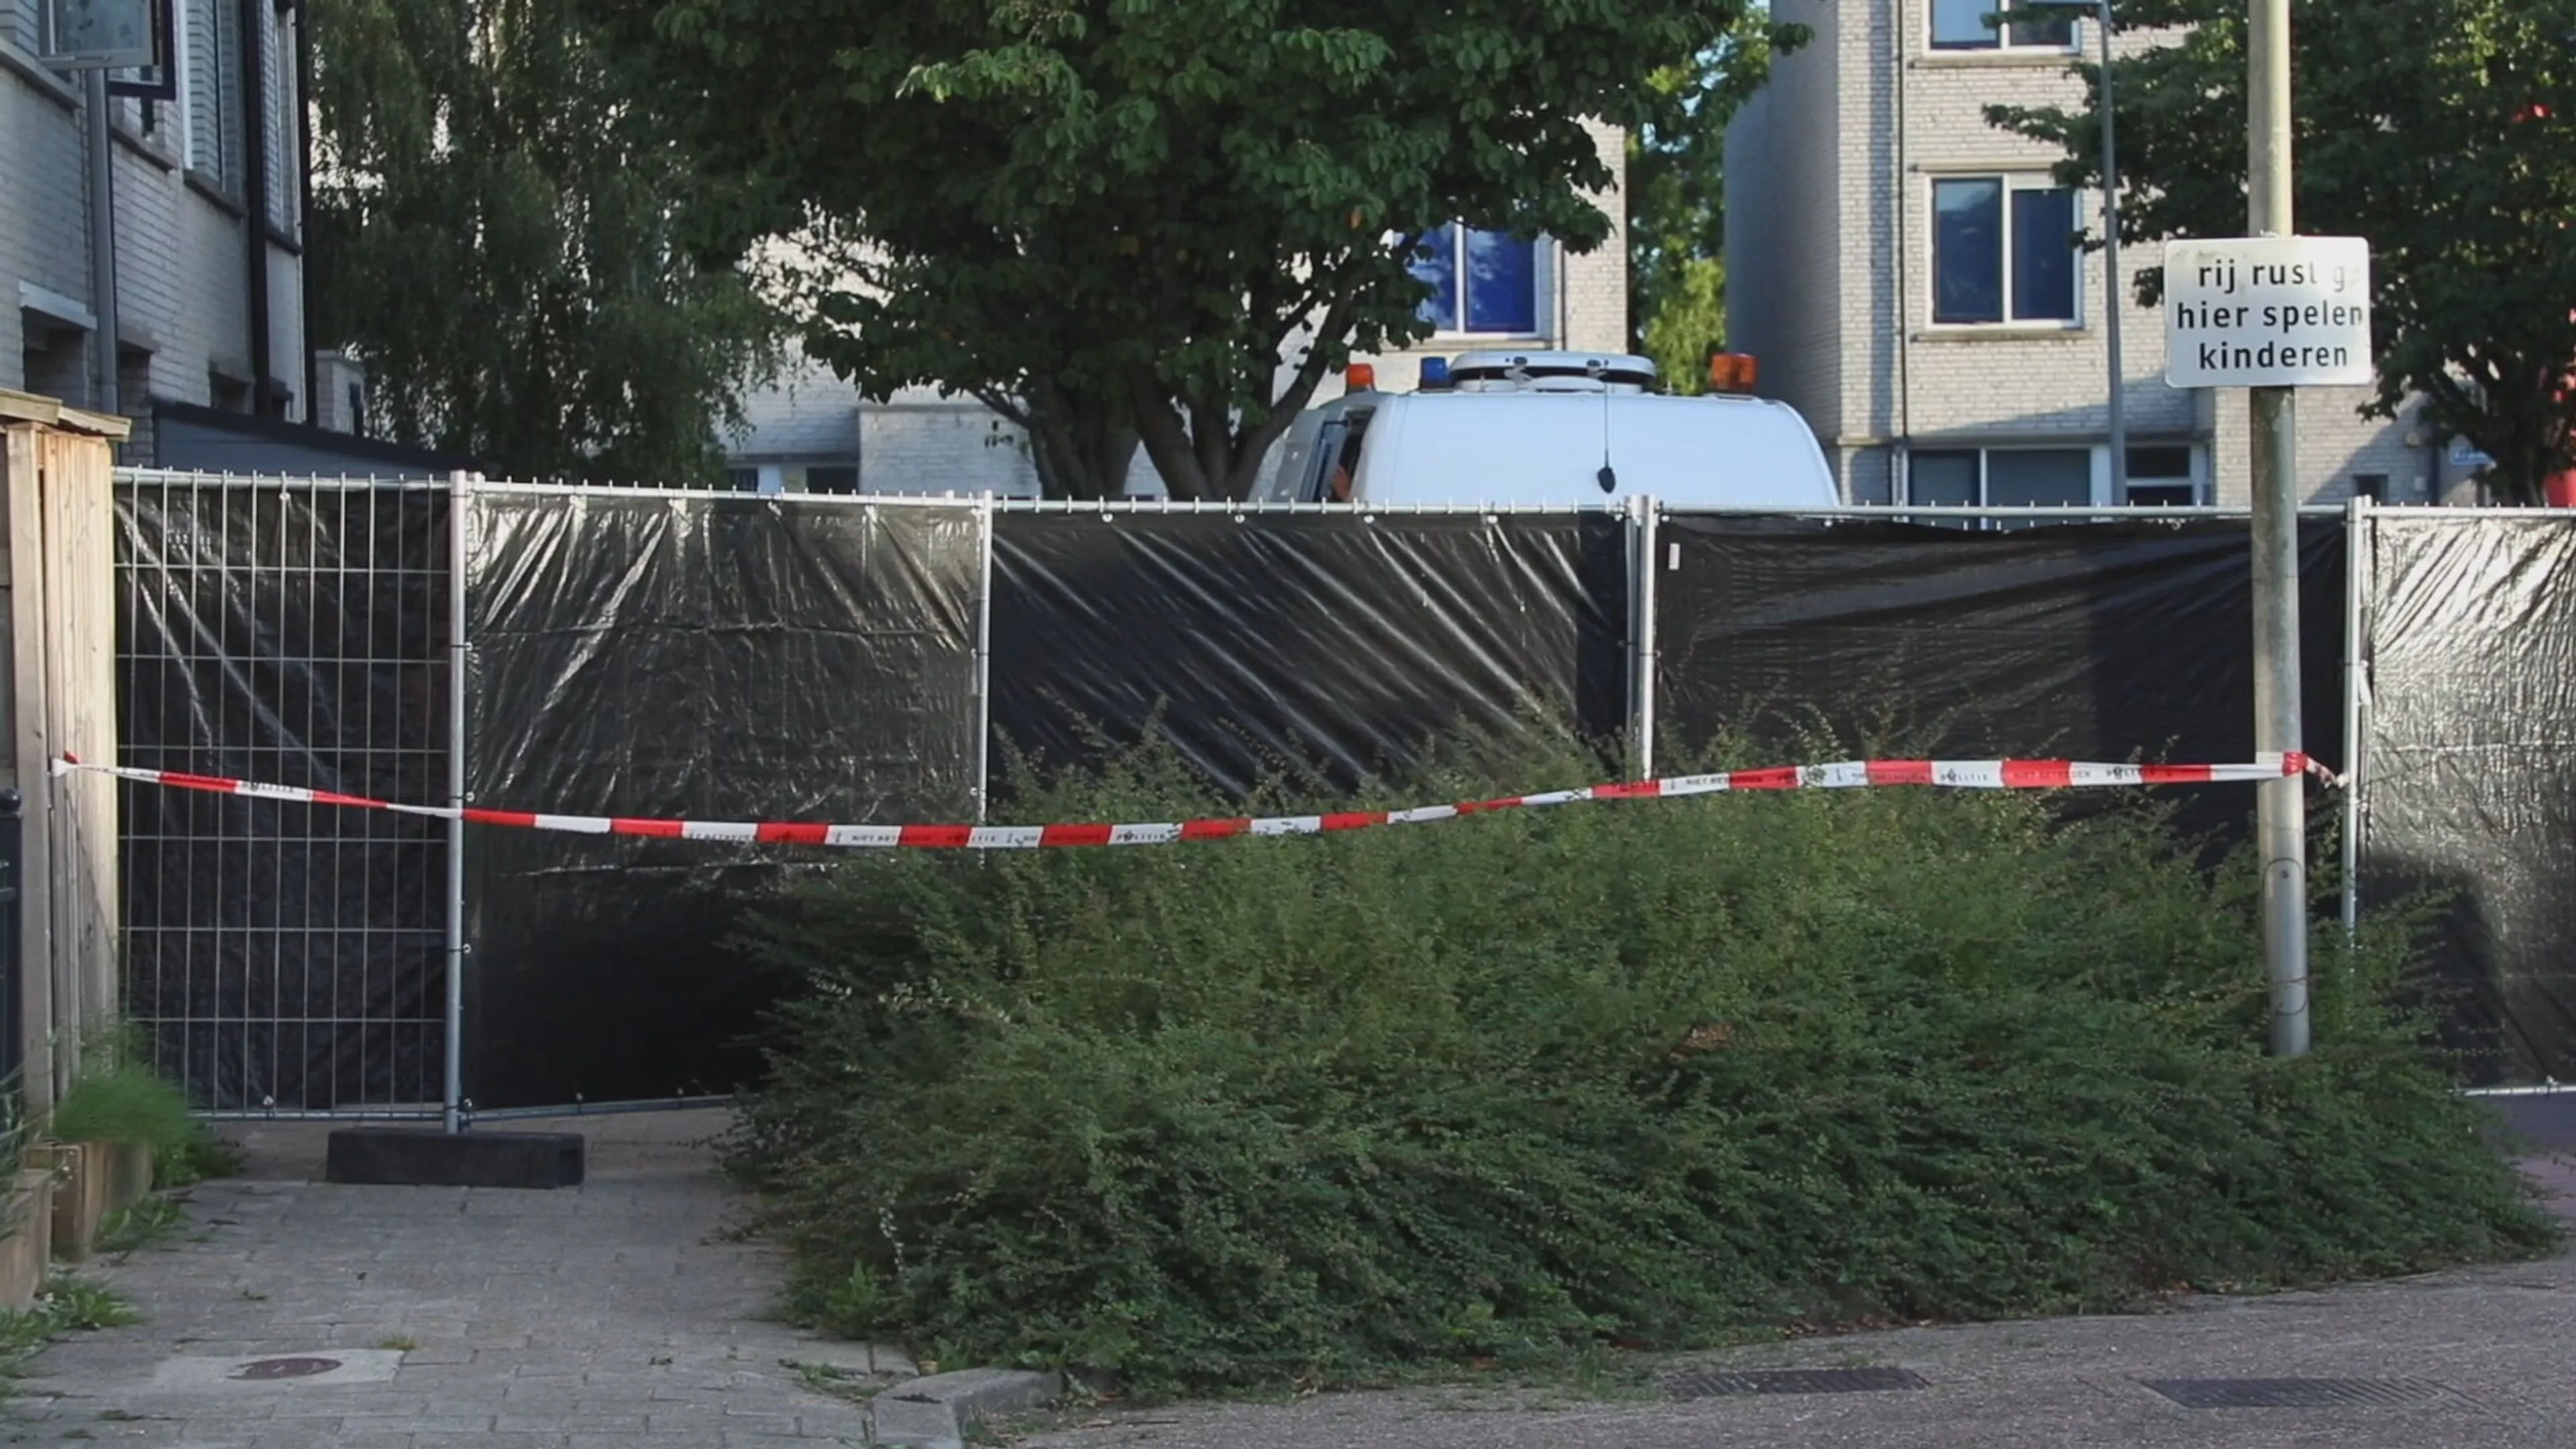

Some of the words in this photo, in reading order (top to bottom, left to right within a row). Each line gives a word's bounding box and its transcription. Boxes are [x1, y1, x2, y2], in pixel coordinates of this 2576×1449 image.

[2199, 258, 2235, 294] rij
[2253, 262, 2345, 292] rustg
[2178, 301, 2249, 329] hier
[2263, 299, 2363, 333] spelen
[2200, 341, 2347, 370] kinderen
